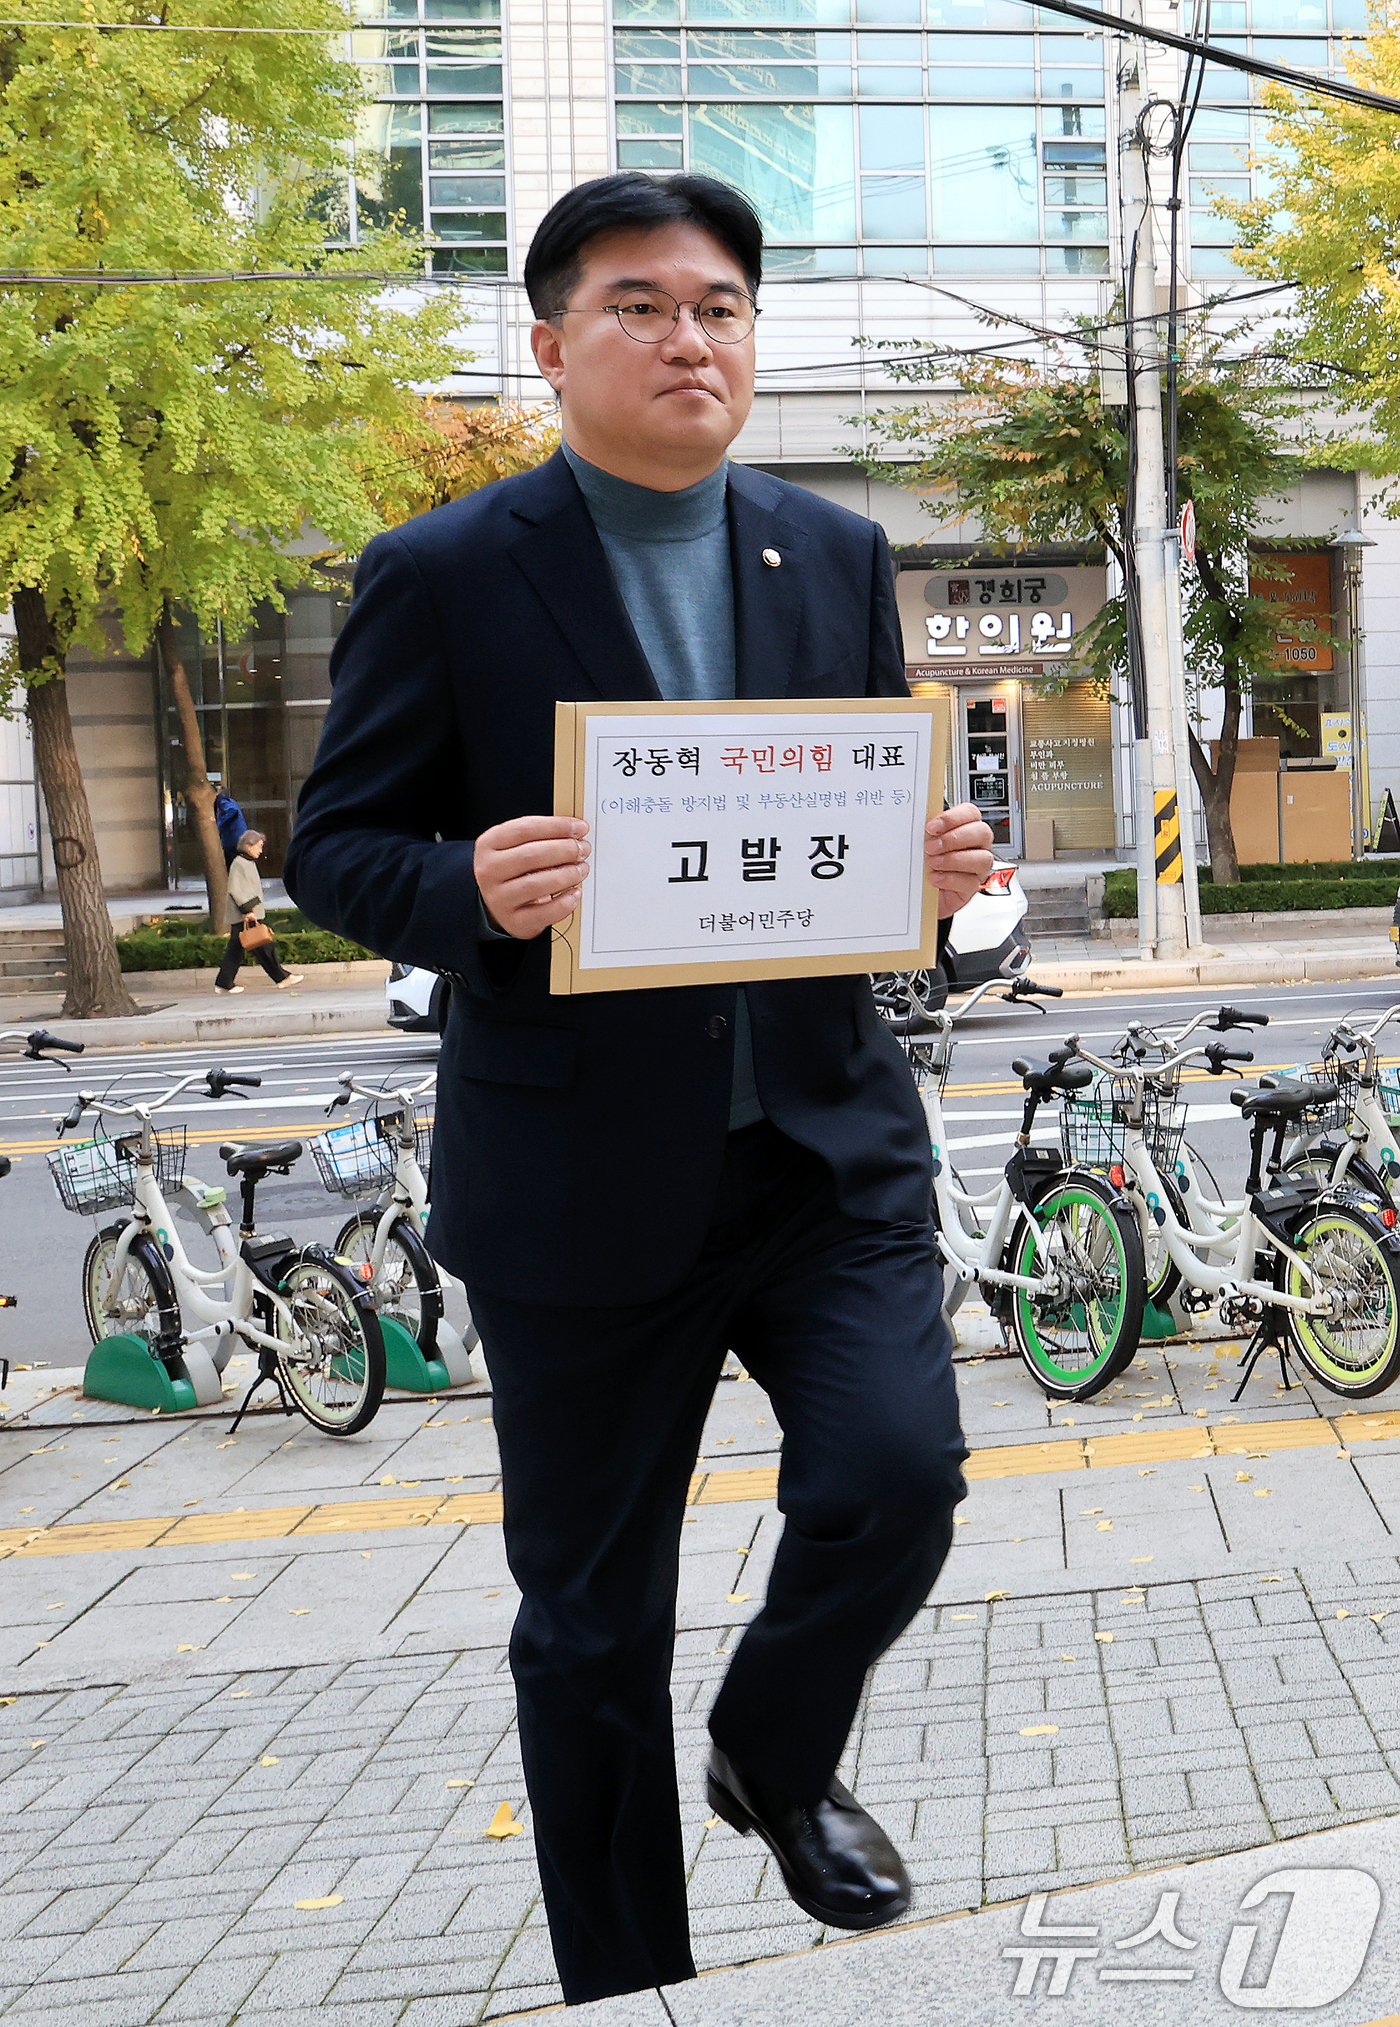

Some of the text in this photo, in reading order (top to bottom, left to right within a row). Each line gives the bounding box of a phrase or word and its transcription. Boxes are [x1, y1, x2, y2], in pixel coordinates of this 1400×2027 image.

[975, 578, 1047, 605] 경희궁
[925, 611, 1073, 656] 한의원
[915, 667, 964, 678] Acupuncture
[972, 666, 998, 676] Korean
[999, 665, 1034, 675] Medicine
[612, 743, 906, 777] 장동혁 국민의힘 대표
[1031, 781, 1104, 792] ACUPUNCTURE
[601, 788, 912, 815] (이해충돌 방지법 및 부동산실명법 위반 등)
[698, 908, 815, 933] 더불어민주당
